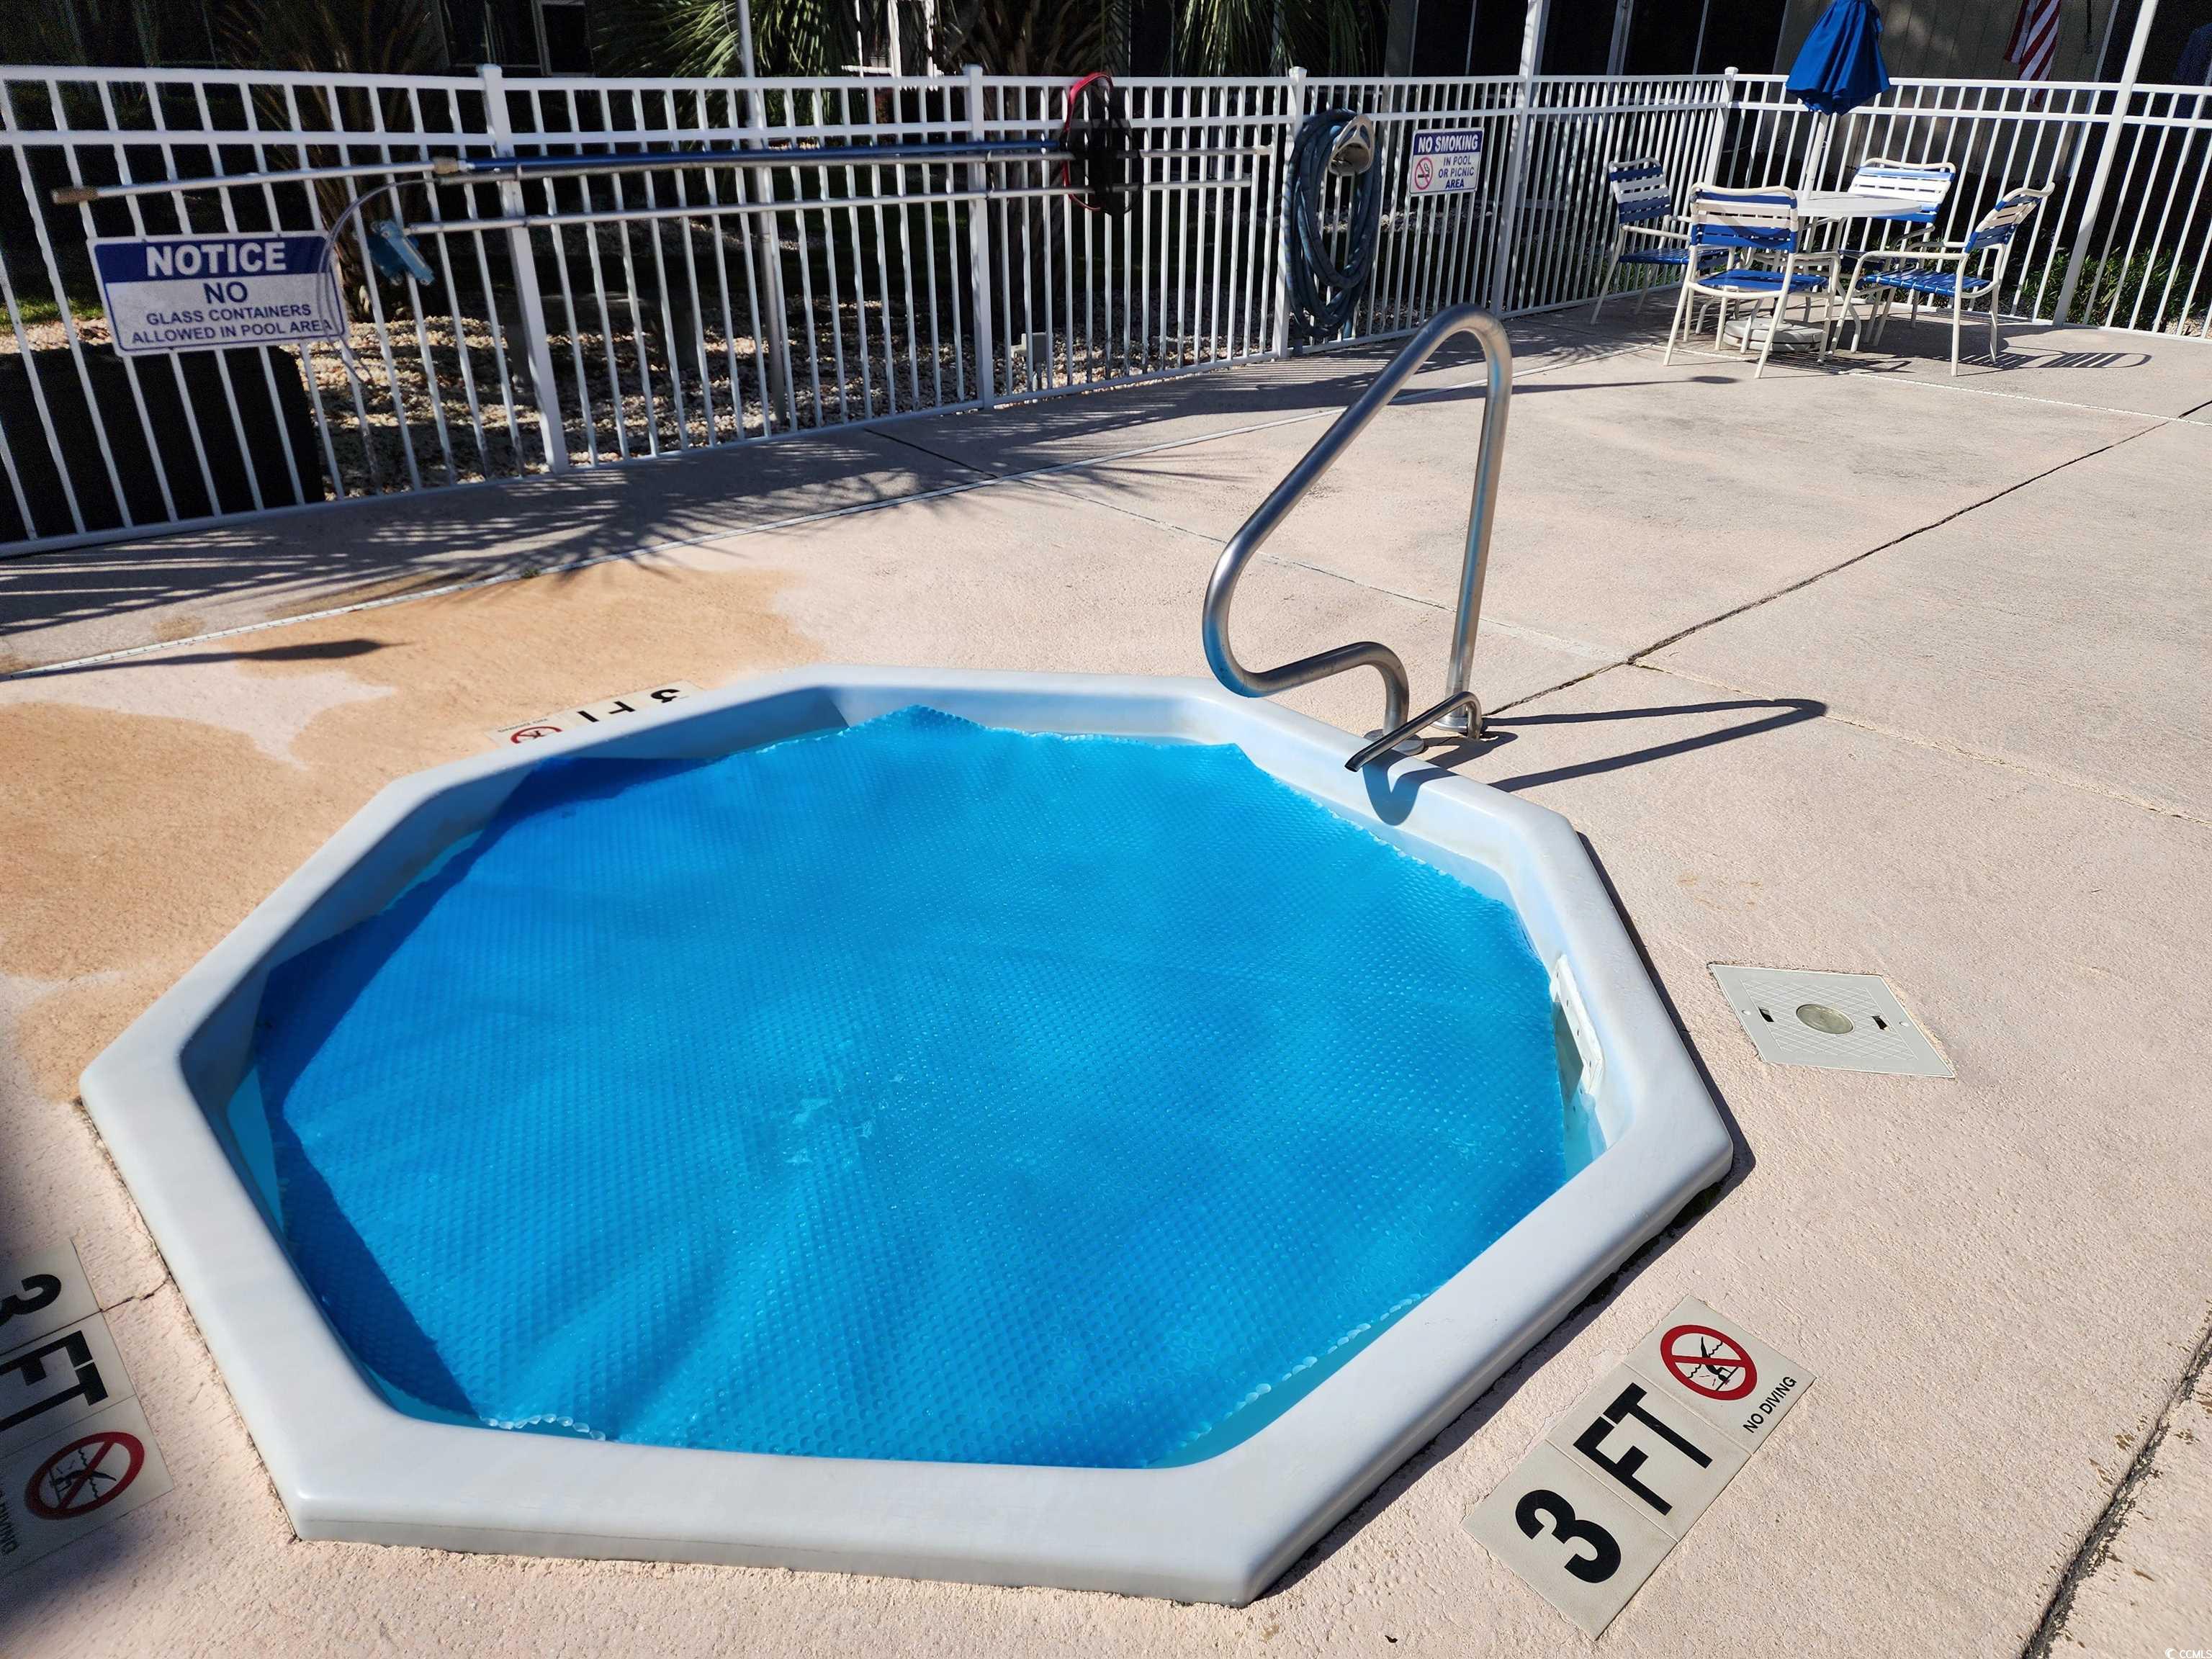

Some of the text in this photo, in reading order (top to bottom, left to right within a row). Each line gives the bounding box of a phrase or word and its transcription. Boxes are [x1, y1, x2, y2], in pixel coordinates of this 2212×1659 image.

[1418, 134, 1478, 153] NO SMOKING
[1444, 156, 1471, 166] IN POOL
[1438, 167, 1474, 178] OR PICNIC
[1446, 179, 1465, 189] AREA
[146, 241, 287, 276] NOTICE
[203, 282, 248, 304] NO
[146, 304, 312, 325] GLASS CONTAINERS
[131, 319, 333, 344] ALLOWED IN POOL AREA
[0, 1330, 109, 1432] FT
[1743, 1376, 1797, 1433] NO DIVING
[1515, 1382, 1713, 1583] 3 FT
